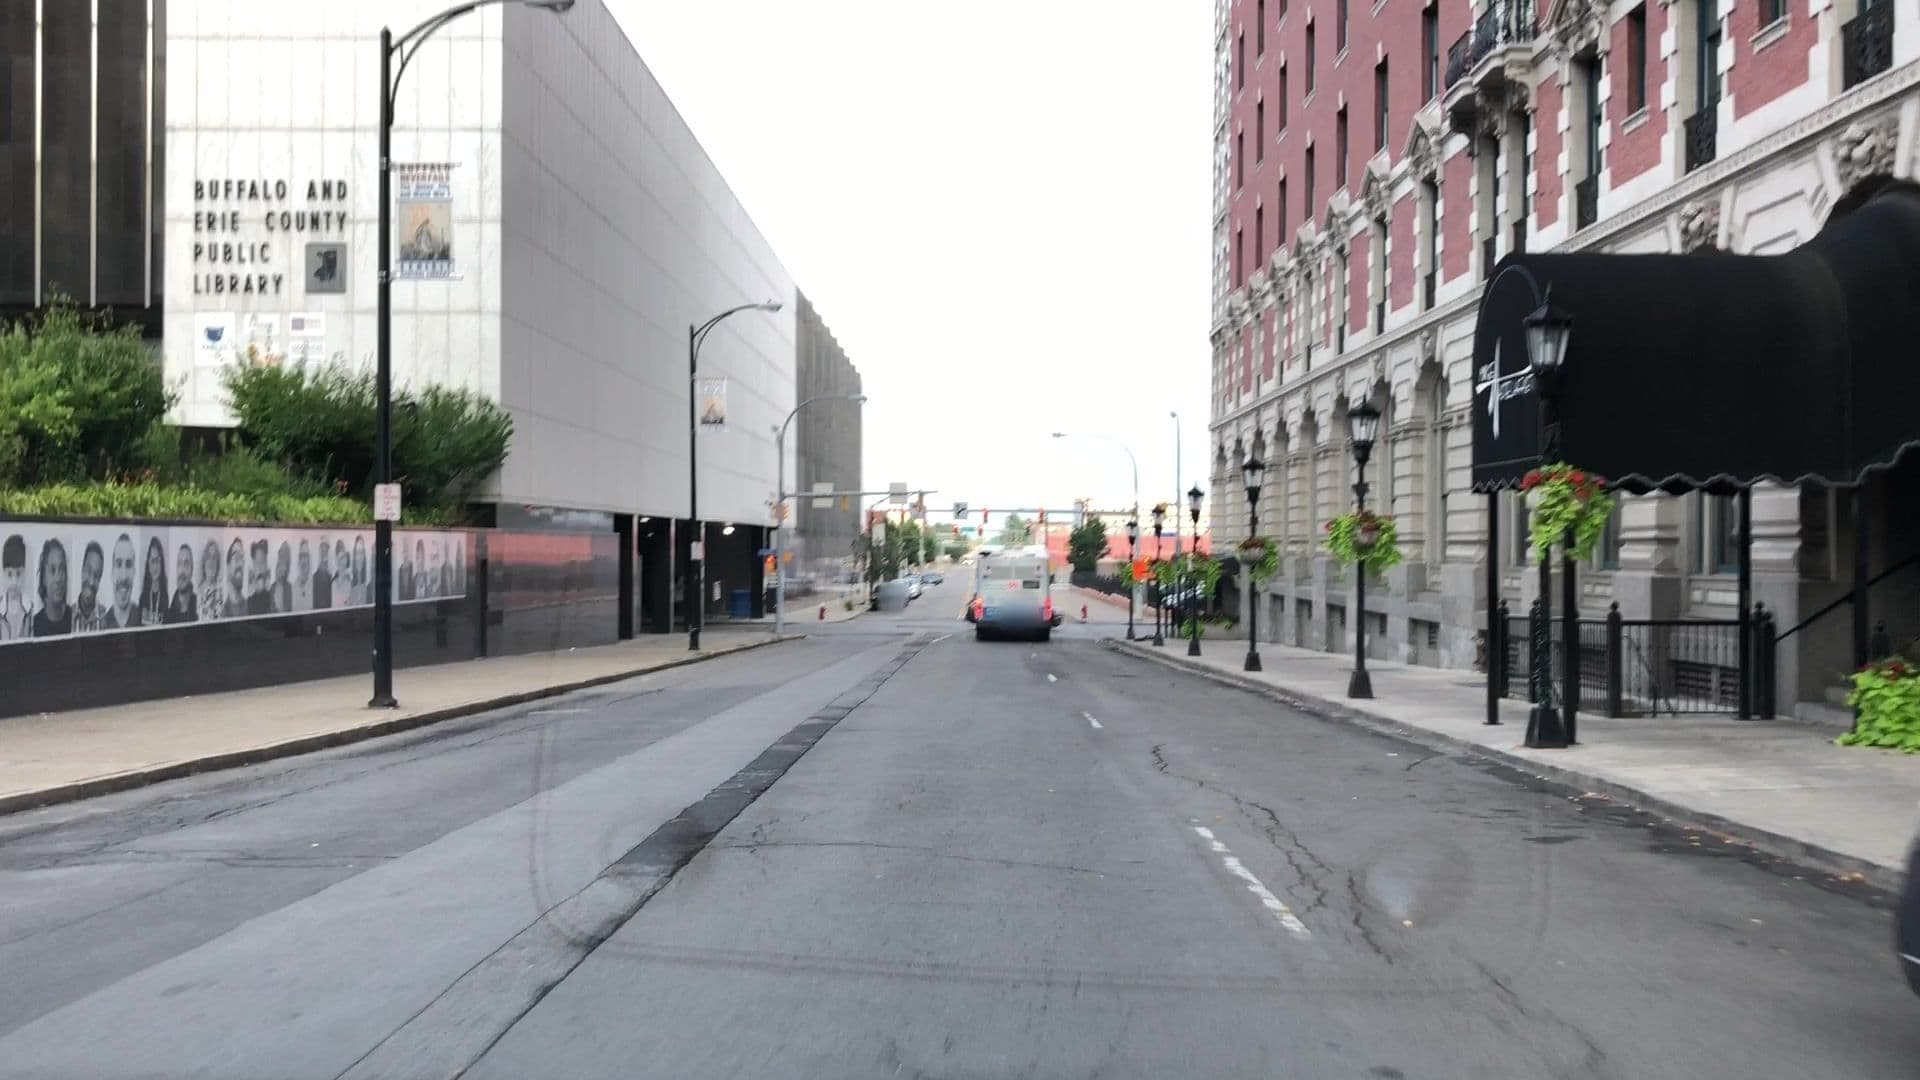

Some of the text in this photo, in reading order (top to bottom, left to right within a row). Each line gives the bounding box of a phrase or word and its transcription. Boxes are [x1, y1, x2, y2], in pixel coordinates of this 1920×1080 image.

[194, 179, 348, 201] BUFFALO AND
[194, 211, 346, 232] ERIE COUNTY
[194, 242, 270, 263] PUBLIC
[194, 274, 282, 295] LIBRARY
